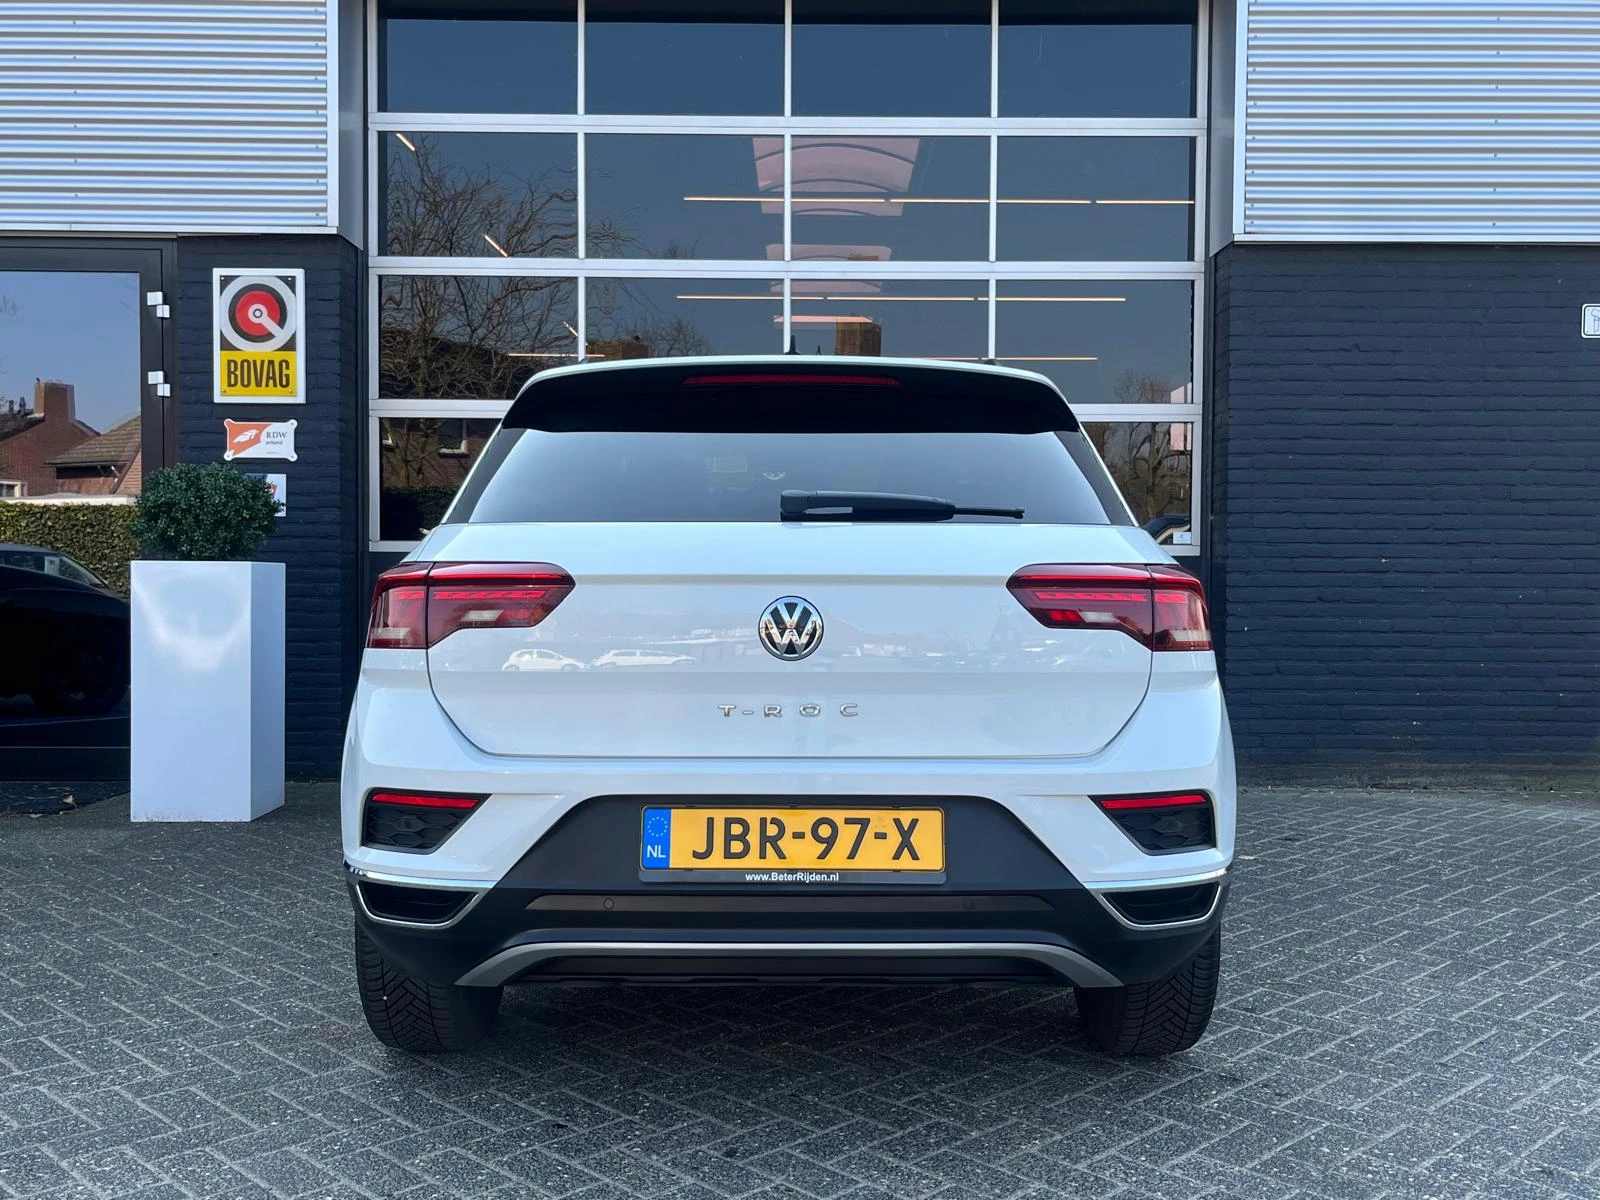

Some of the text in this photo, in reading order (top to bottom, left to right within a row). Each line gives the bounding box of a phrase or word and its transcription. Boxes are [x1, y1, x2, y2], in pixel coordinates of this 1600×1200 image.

[227, 359, 290, 388] BOVAG
[718, 703, 858, 717] T-ROC
[692, 817, 920, 860] JBR-97-X
[646, 845, 666, 858] NL
[745, 872, 839, 883] www.BeterRijden.nl
